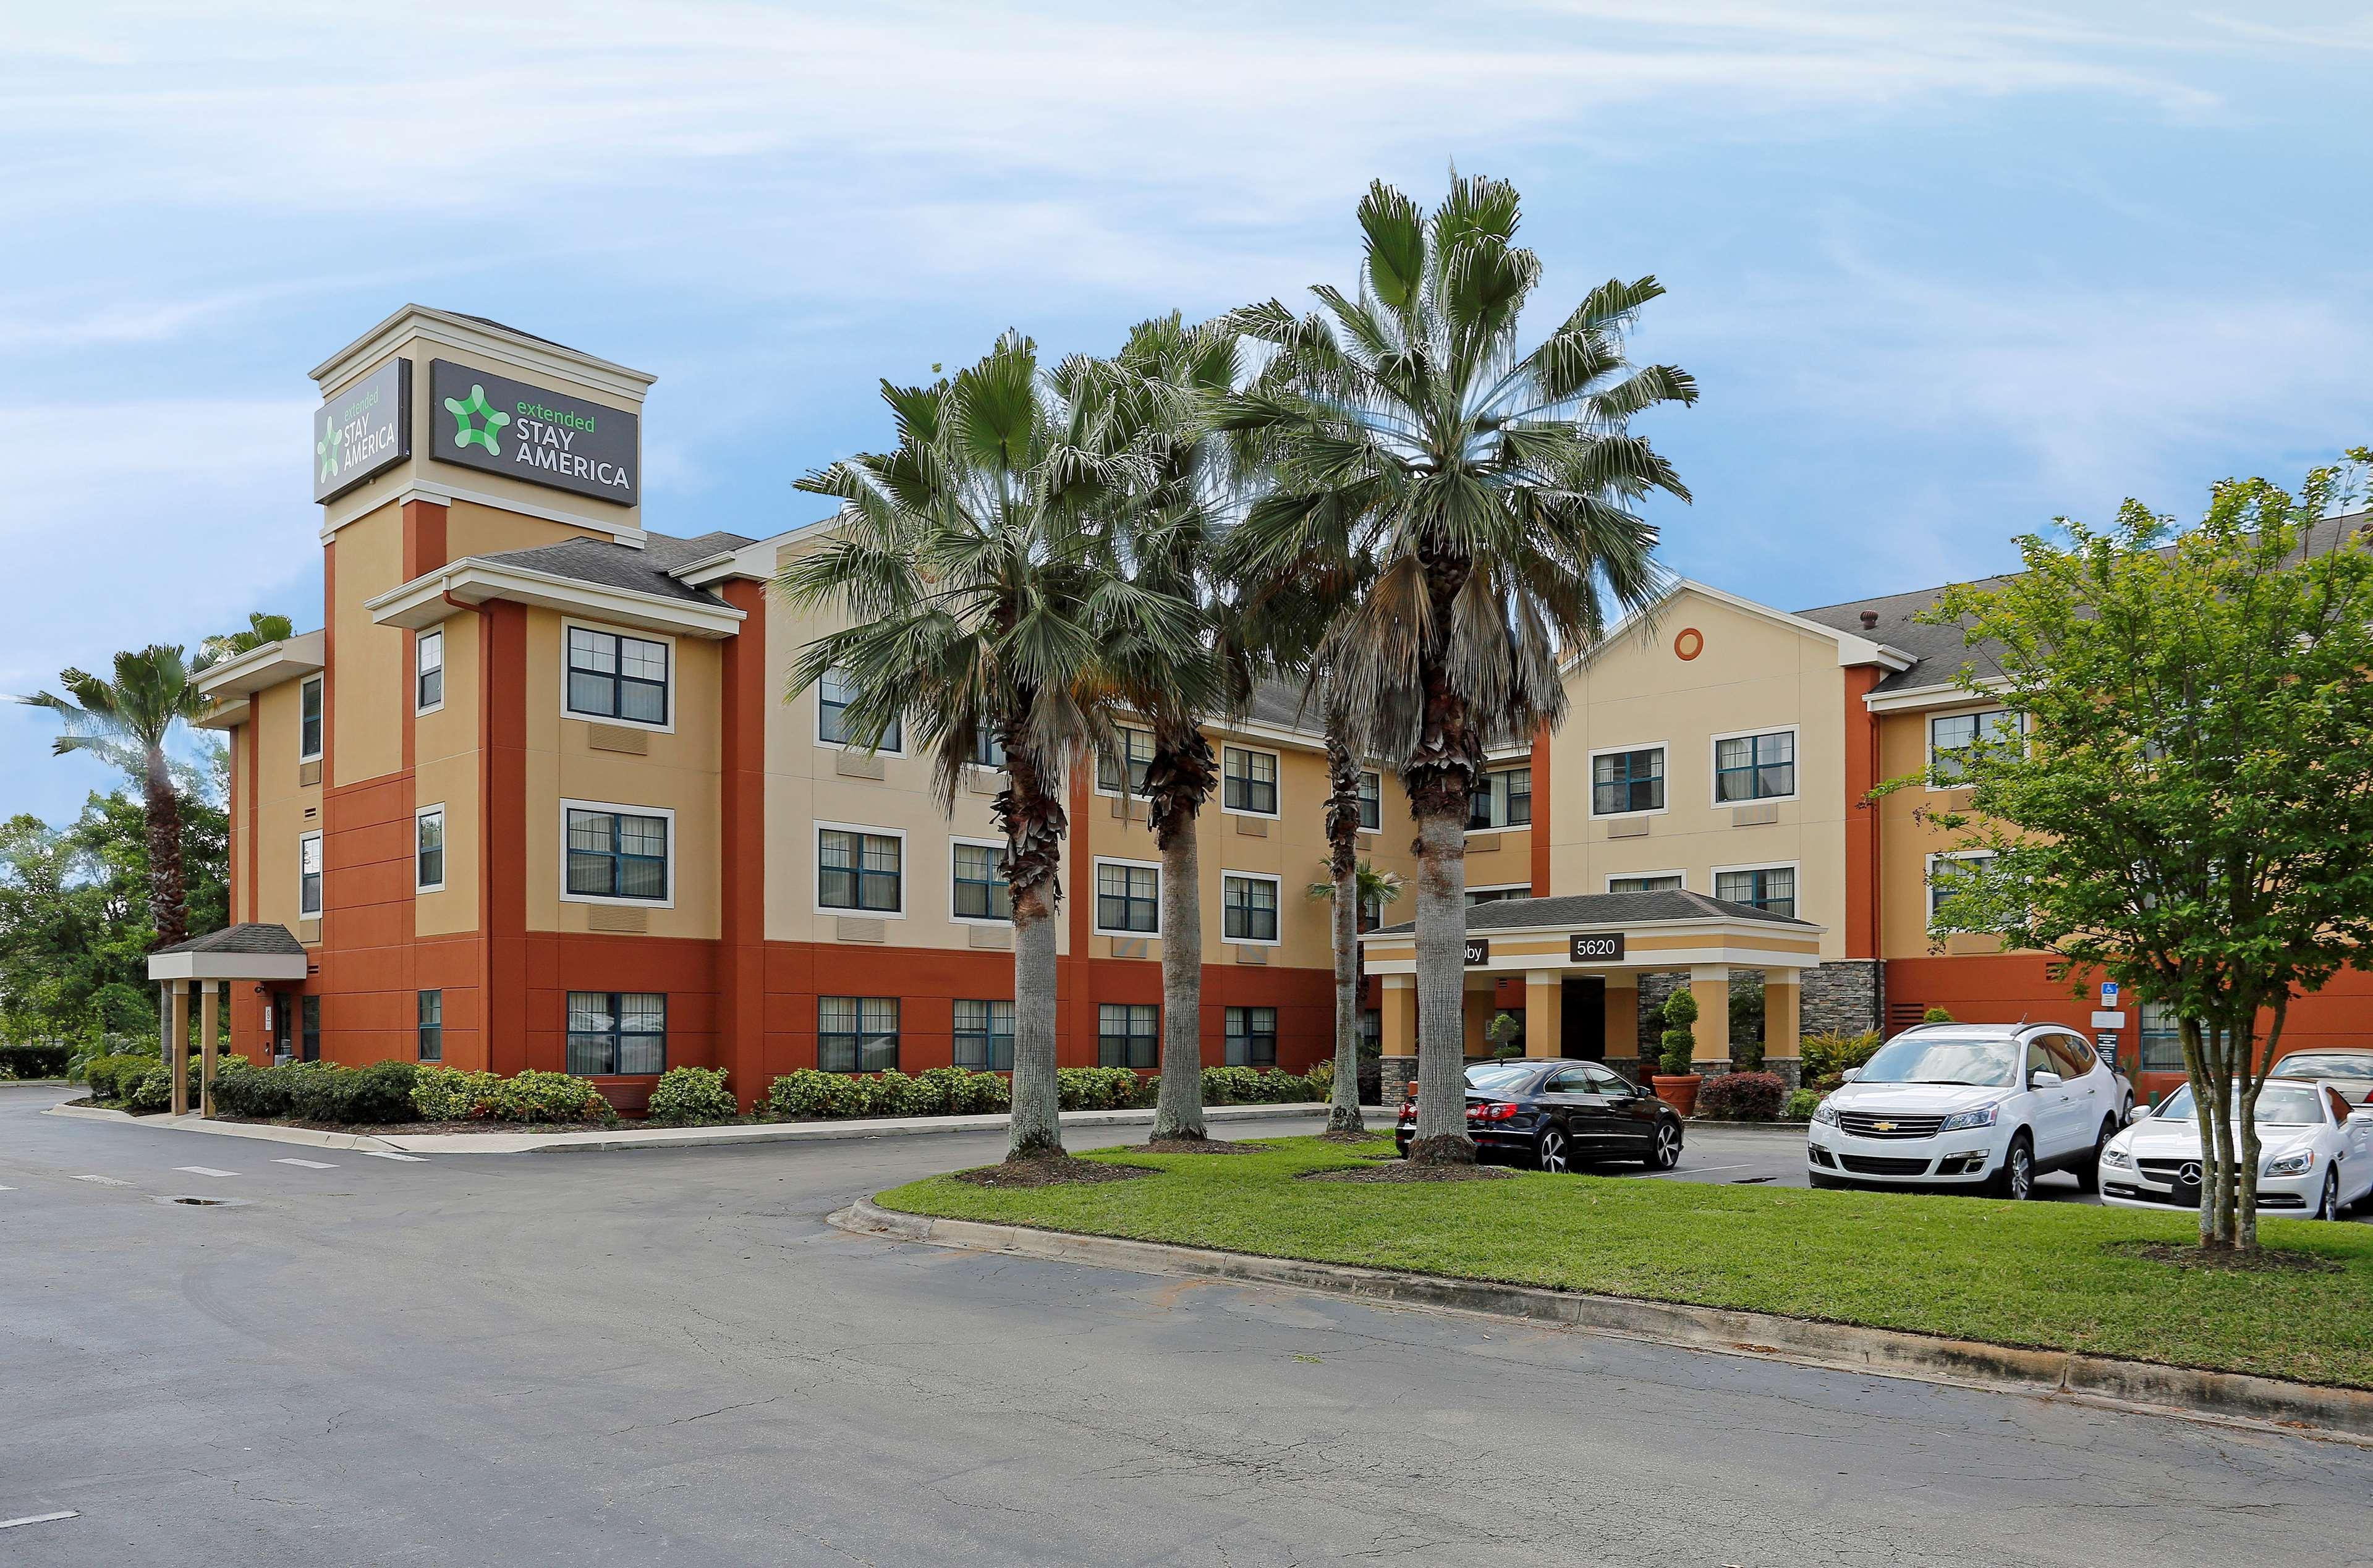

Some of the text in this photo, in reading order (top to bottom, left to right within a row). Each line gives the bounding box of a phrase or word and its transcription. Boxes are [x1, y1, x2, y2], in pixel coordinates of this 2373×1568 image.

[344, 385, 379, 422] extended
[516, 401, 595, 433] extended
[344, 412, 370, 447] STAY
[516, 418, 575, 451] STAY
[344, 423, 395, 472] AMERICA
[516, 442, 630, 489] AMERICA
[1577, 939, 1615, 956] 5620
